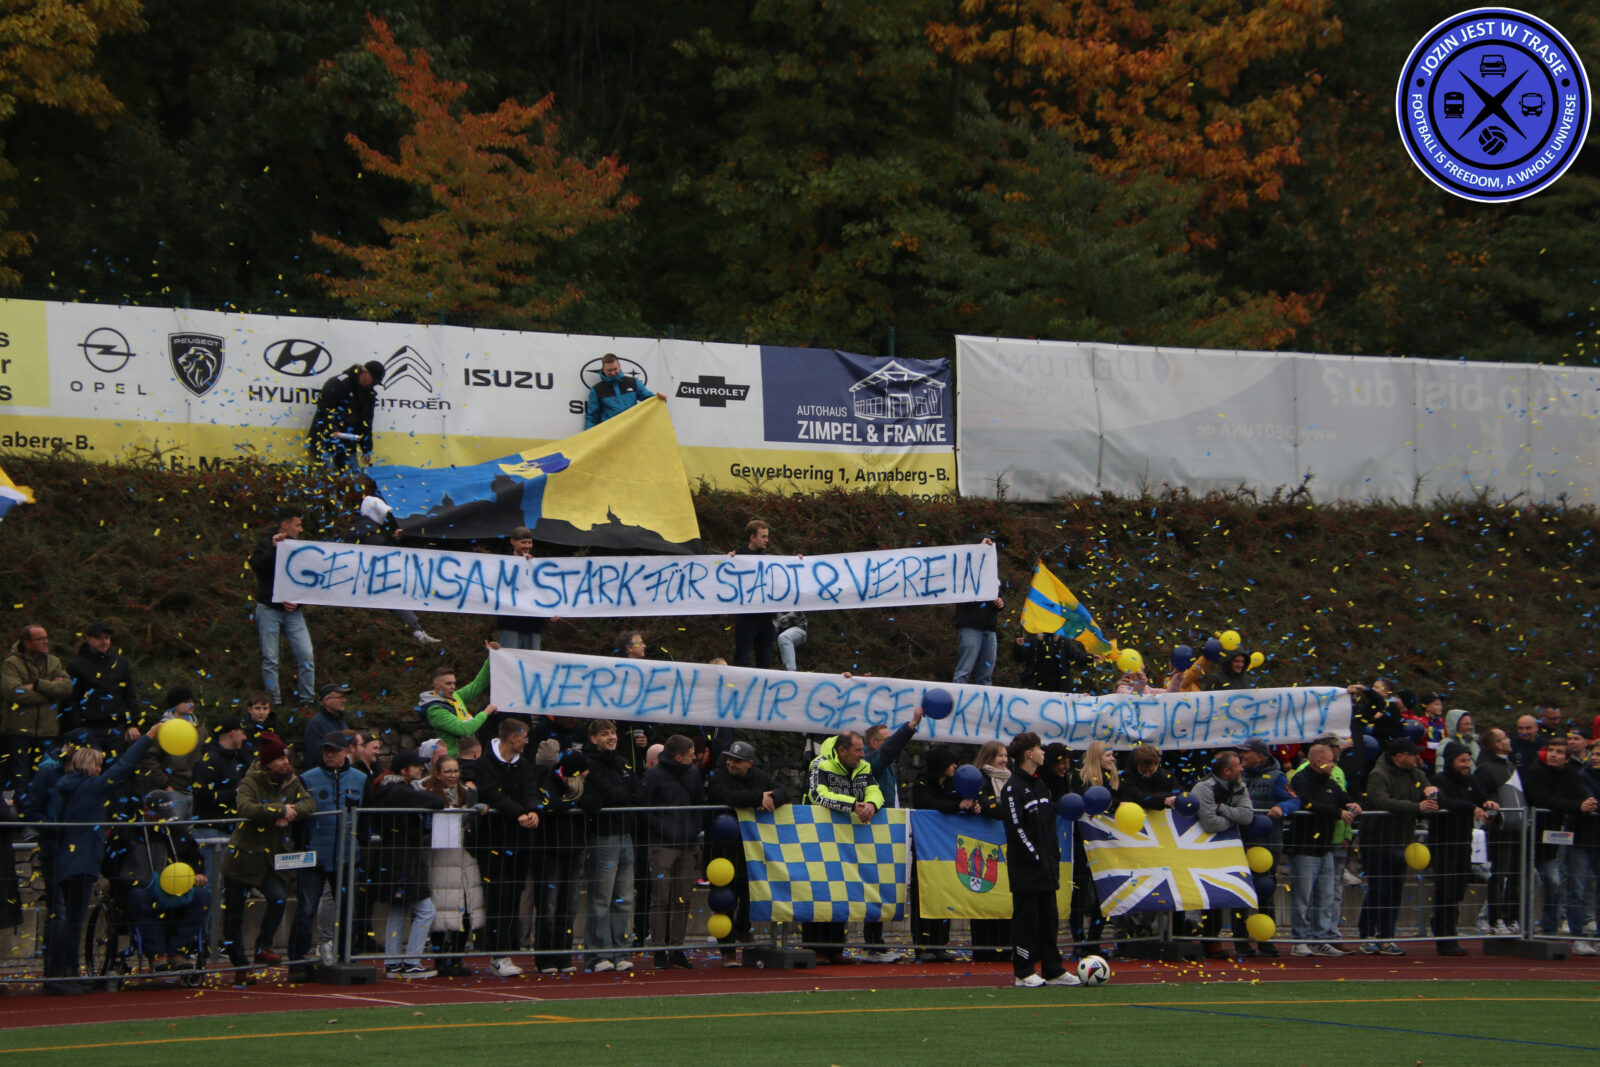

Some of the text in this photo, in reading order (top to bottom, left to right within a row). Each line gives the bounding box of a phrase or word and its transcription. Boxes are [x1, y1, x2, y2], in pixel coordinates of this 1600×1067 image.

[173, 336, 220, 347] PEUGEOT
[70, 380, 147, 396] OPEL
[464, 368, 554, 390] ISUZU
[248, 385, 324, 405] HYUND
[680, 385, 746, 398] CHEVROLET
[796, 404, 848, 418] AUTOHAUS
[797, 421, 947, 443] ZIMPEL & FRANKE
[730, 463, 834, 484] Gewerbering
[838, 468, 850, 484] 1,
[855, 467, 950, 485] Annaberg-B.
[285, 546, 986, 611] GEMEINSAM STARK FÜR STADT & VEREIN
[518, 660, 700, 718] WERDEN
[716, 674, 800, 721] WIR
[949, 688, 1029, 739] KMS
[1040, 693, 1215, 745] SIEGREICH
